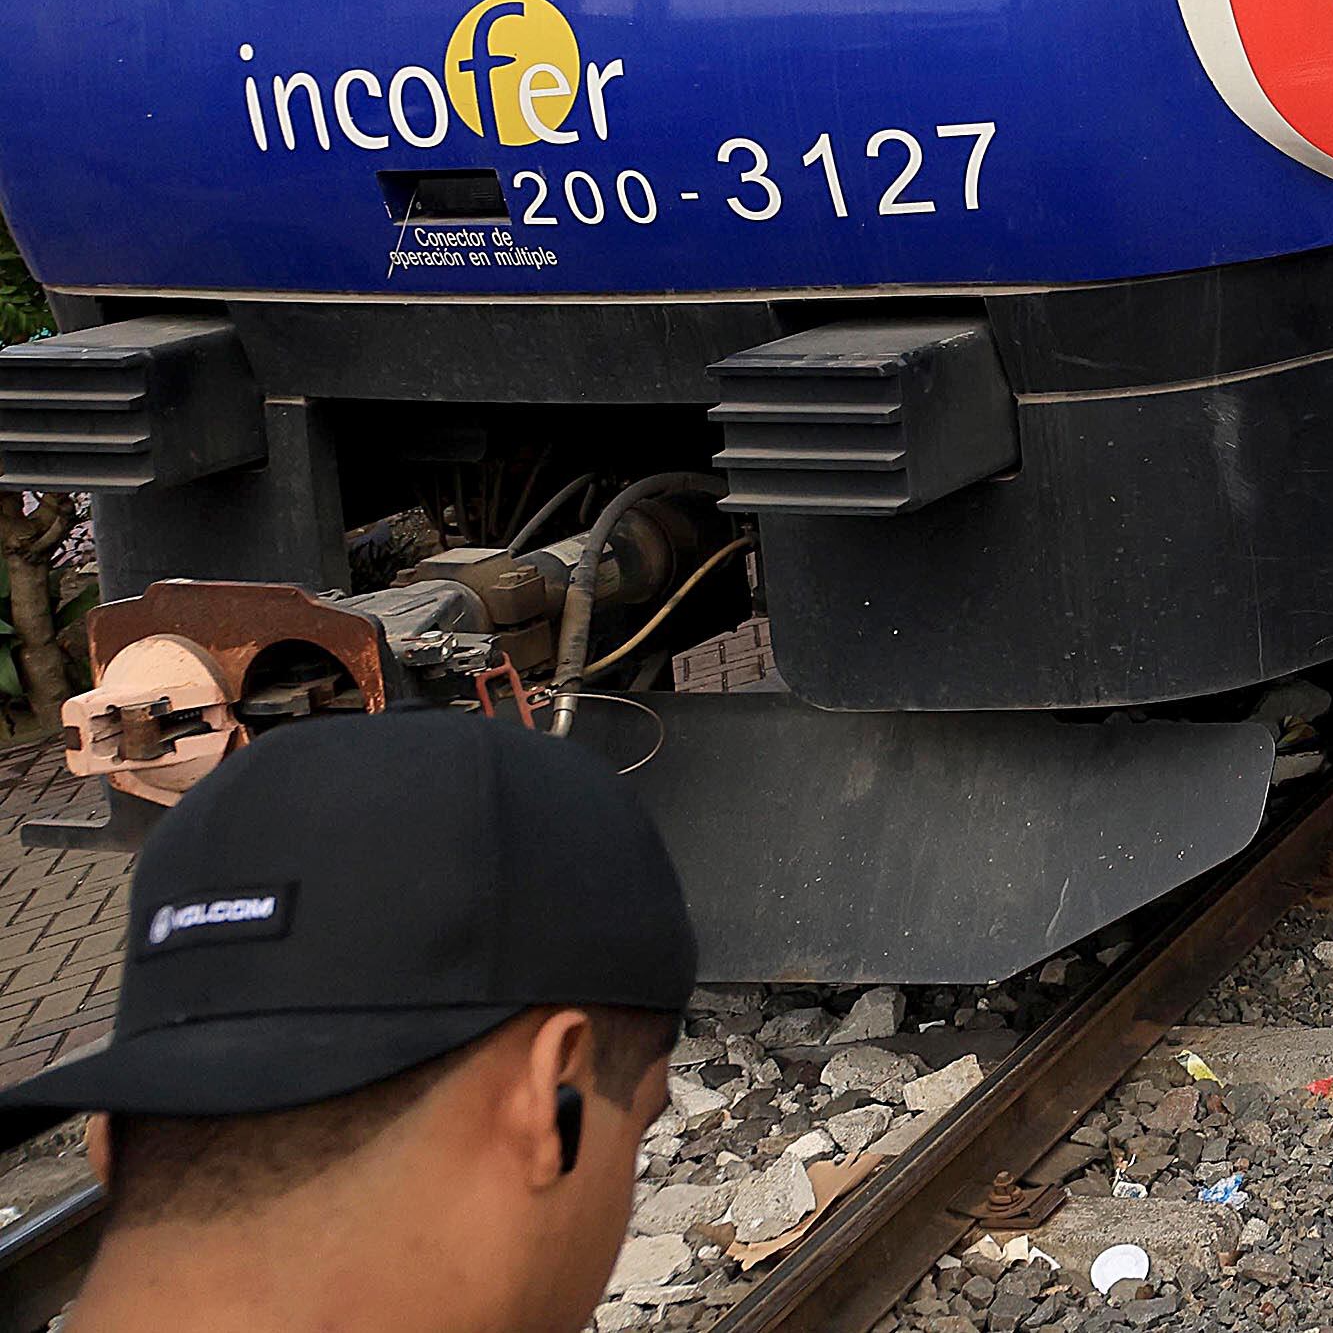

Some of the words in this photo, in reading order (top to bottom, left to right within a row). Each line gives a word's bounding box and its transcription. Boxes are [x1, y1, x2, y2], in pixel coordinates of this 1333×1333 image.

[238, 2, 625, 151] incofer
[414, 227, 486, 247] Conector
[492, 227, 513, 247] de
[389, 248, 466, 270] operación
[470, 251, 491, 266] en
[494, 247, 558, 270] múltiple
[174, 896, 276, 930] VOLCOM
